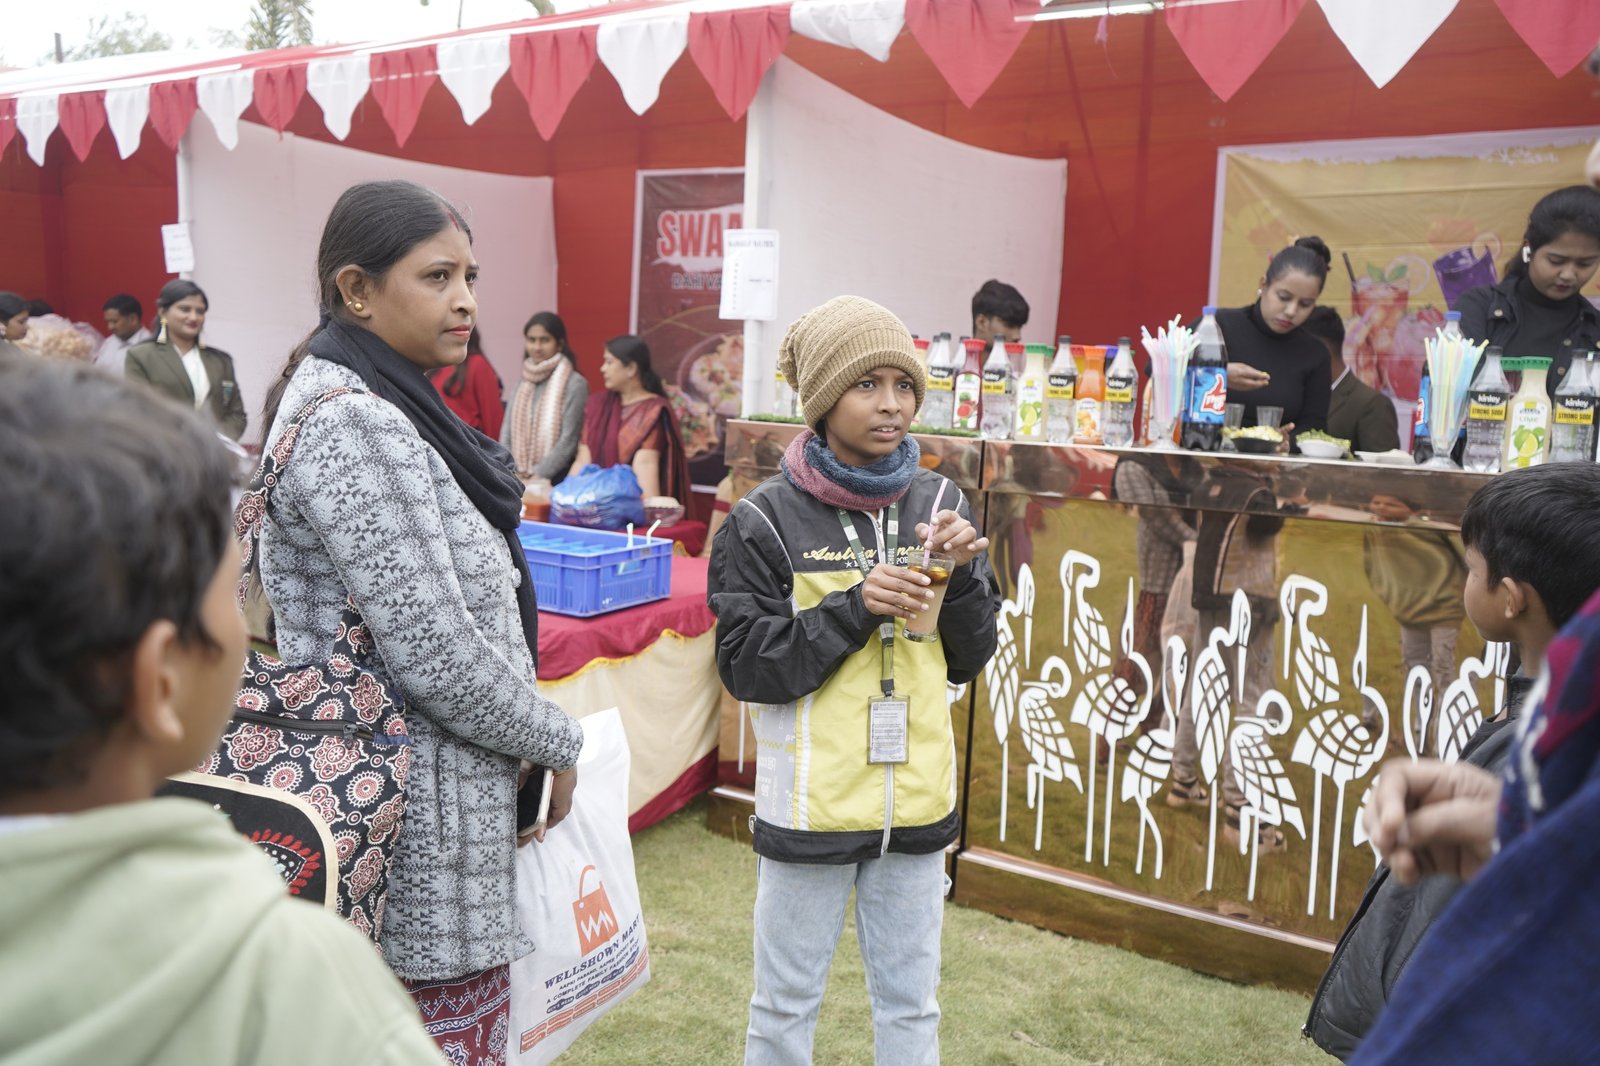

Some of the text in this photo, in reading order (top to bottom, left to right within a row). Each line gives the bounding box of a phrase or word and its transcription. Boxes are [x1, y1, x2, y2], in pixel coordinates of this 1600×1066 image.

[1478, 393, 1501, 404] kinley
[1565, 397, 1589, 408] kinley
[544, 940, 620, 989] WELLSHOWN
[622, 912, 640, 942] MART
[553, 981, 586, 1001] COMPLETE
[588, 968, 608, 982] FAMILY
